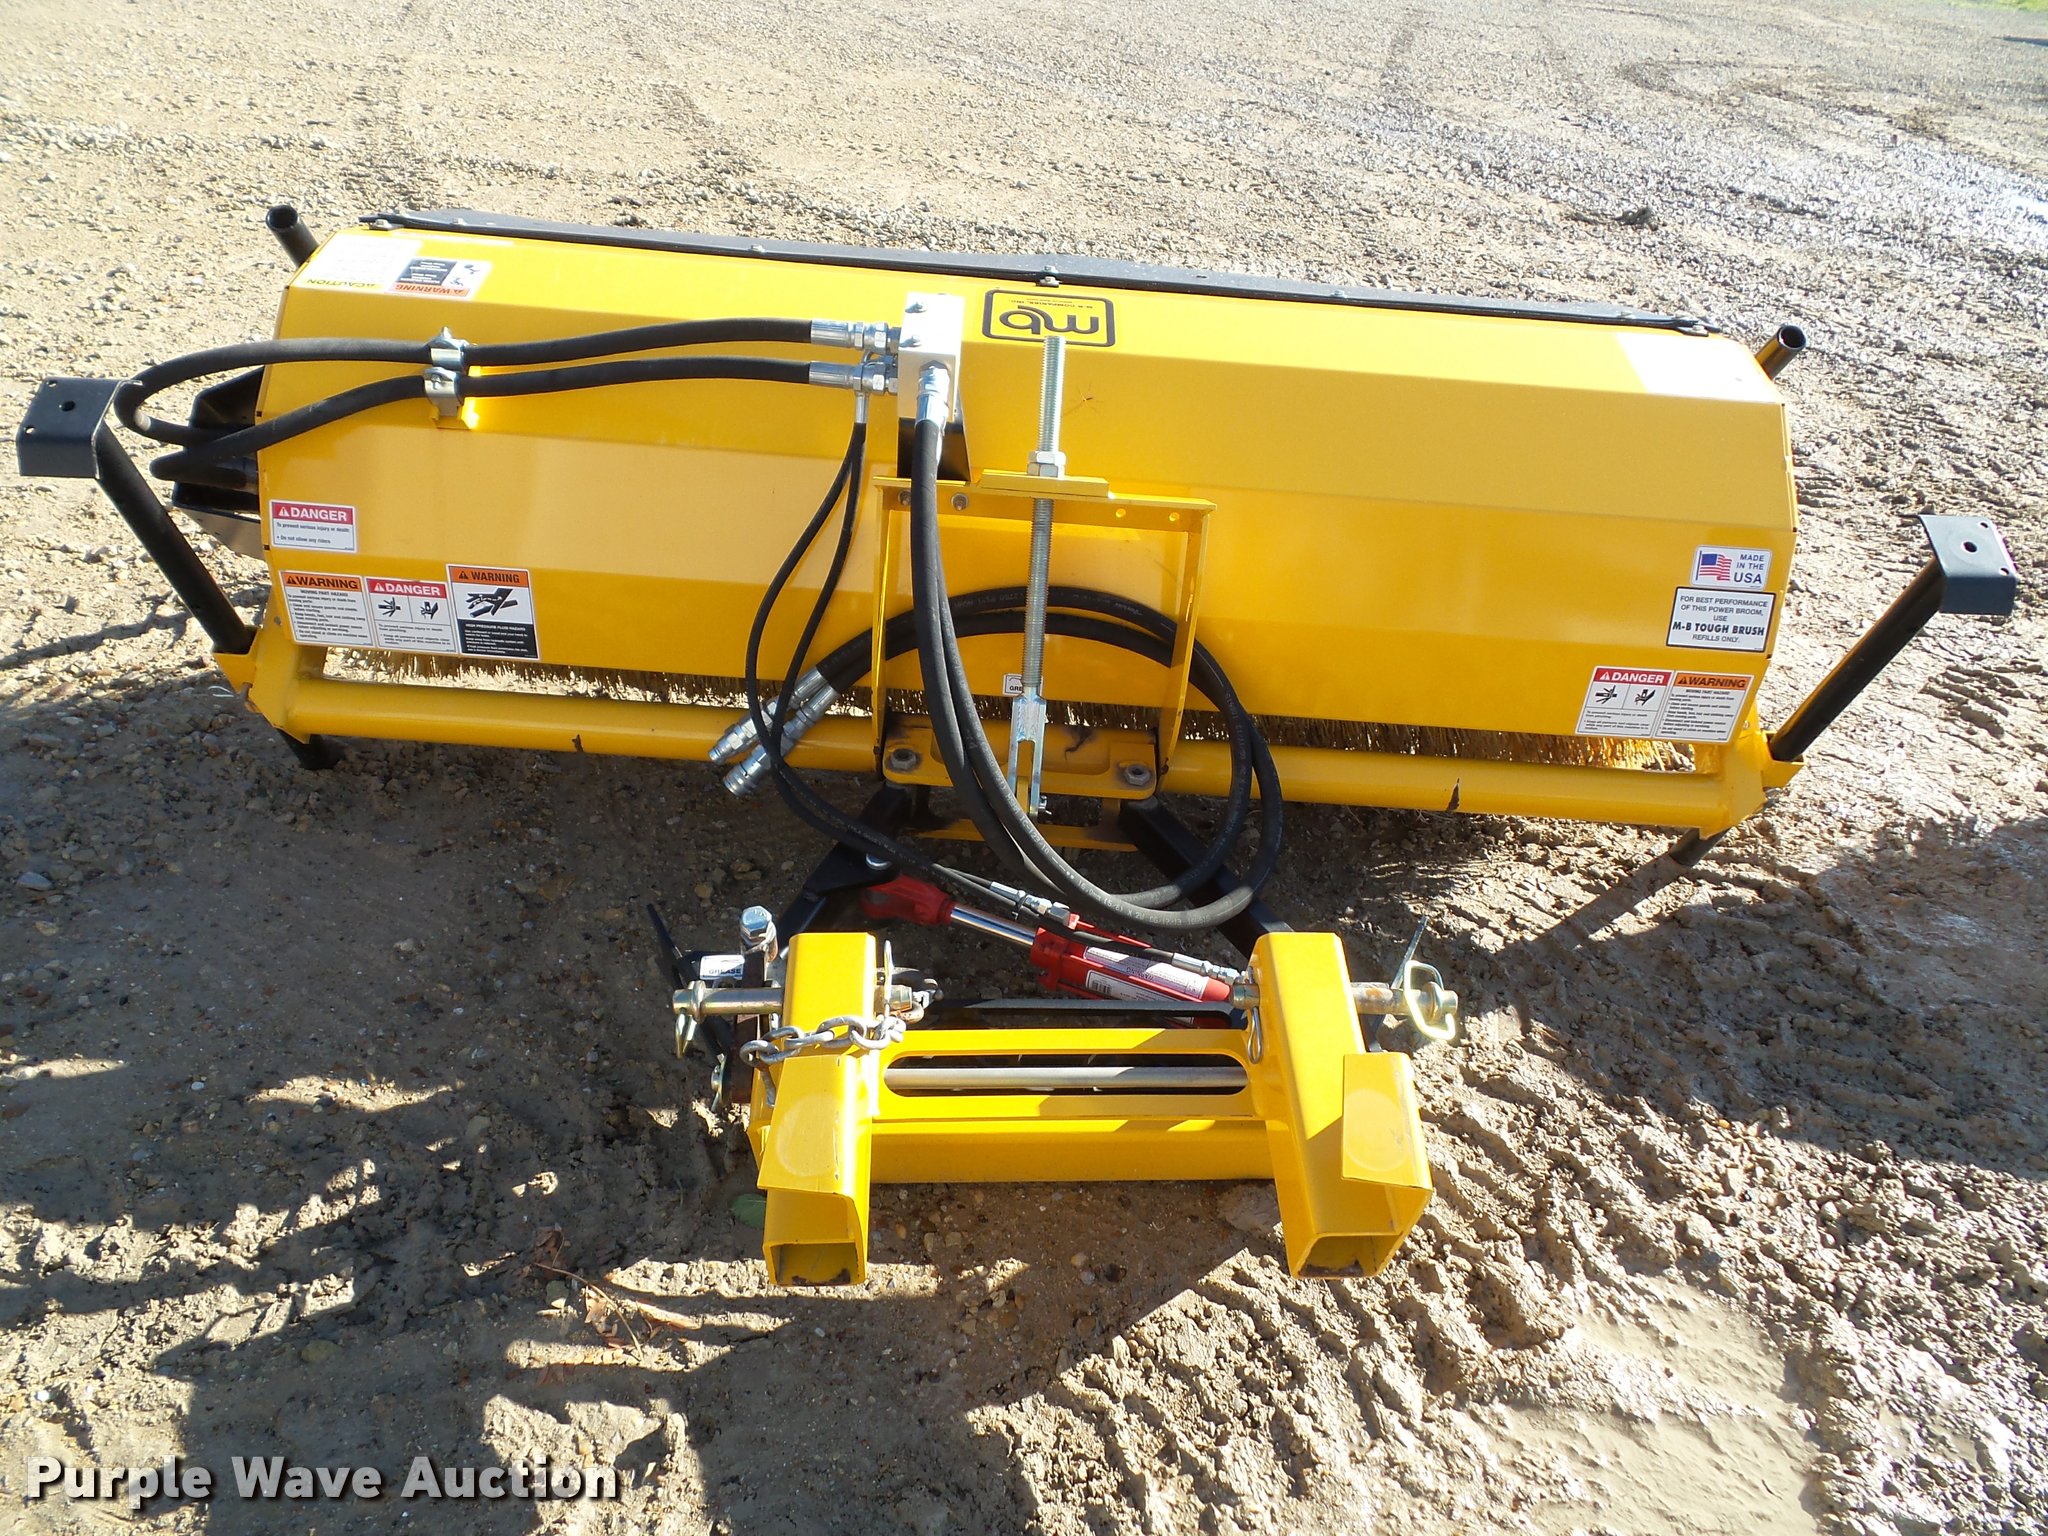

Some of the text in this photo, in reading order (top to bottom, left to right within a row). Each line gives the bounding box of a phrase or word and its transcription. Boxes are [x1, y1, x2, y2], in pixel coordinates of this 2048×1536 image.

[395, 284, 451, 295] WARNING
[999, 305, 1099, 335] mb
[290, 507, 347, 522] DANGER
[296, 576, 359, 590] WARNING
[471, 572, 520, 584] WARNING
[1733, 572, 1762, 584] USA
[385, 583, 440, 596] DANGER
[1714, 598, 1768, 608] PERFORMANCE
[1672, 622, 1765, 636] M-B TOUGH BRUSH
[1611, 672, 1665, 684] DANGER
[1688, 677, 1746, 688] WARNING
